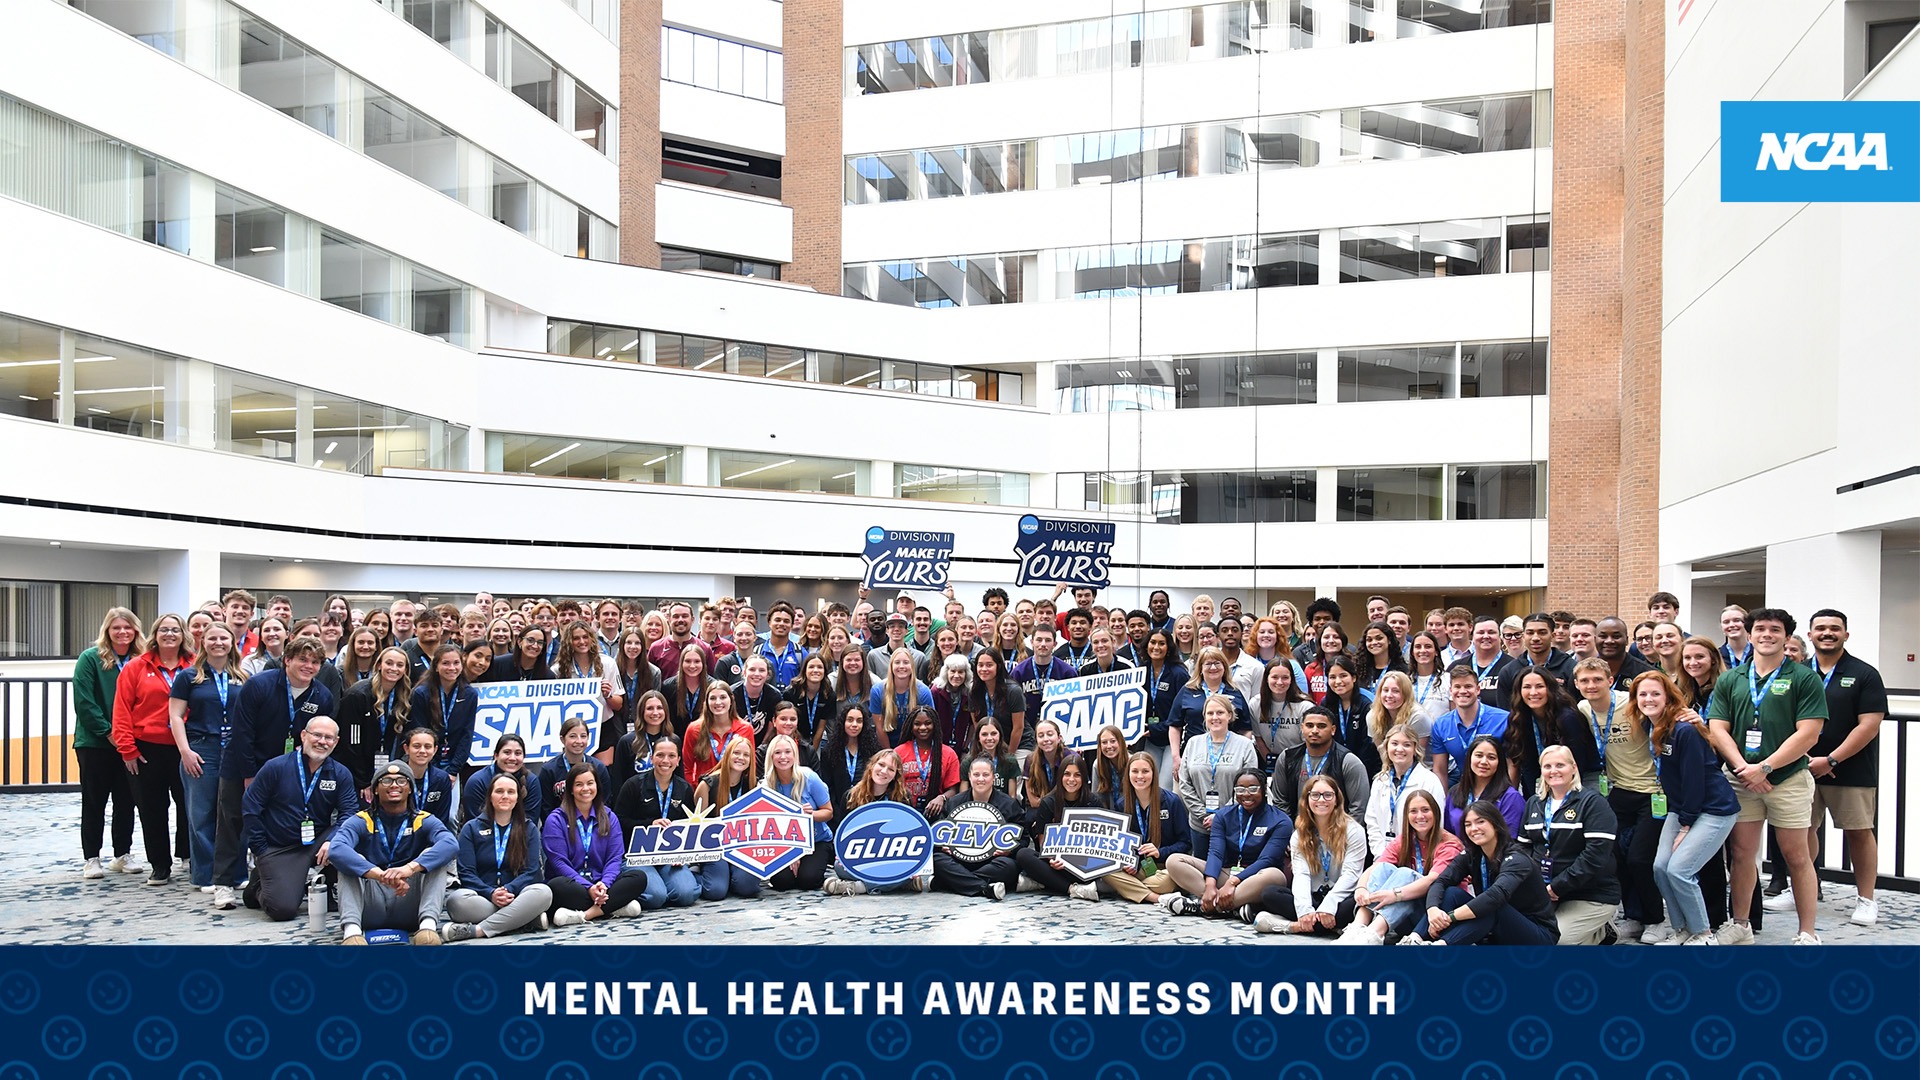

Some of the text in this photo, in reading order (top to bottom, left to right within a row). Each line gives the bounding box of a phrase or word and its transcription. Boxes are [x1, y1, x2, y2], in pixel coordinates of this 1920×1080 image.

[1045, 521, 1111, 534] DIVISION II
[890, 532, 950, 543] DIVISION II
[895, 547, 952, 560] MAKE IT
[1051, 540, 1112, 554] MAKE IT
[861, 550, 949, 589] YOURS
[1016, 543, 1109, 586] YOURS
[477, 681, 597, 699] NCAA DIVISION II
[1046, 671, 1143, 697] NCAA DIVISION II
[1044, 688, 1143, 748] SAAC
[470, 699, 598, 761] SAAC
[951, 804, 966, 817] GREAT
[986, 805, 1002, 820] VALLEY
[630, 823, 726, 853] NSIC
[722, 817, 806, 845] MIAA
[931, 820, 1022, 850] GLVC
[1071, 821, 1116, 837] GREAT
[844, 835, 927, 859] GLIAC
[1045, 826, 1138, 856] MIDWEST
[628, 858, 650, 866] Northern
[661, 855, 693, 864] Intercollegiate
[694, 854, 719, 862] Conference
[752, 848, 775, 857] 1912
[953, 850, 990, 861] CONFERENCE
[1084, 848, 1135, 864] CONFERENCE
